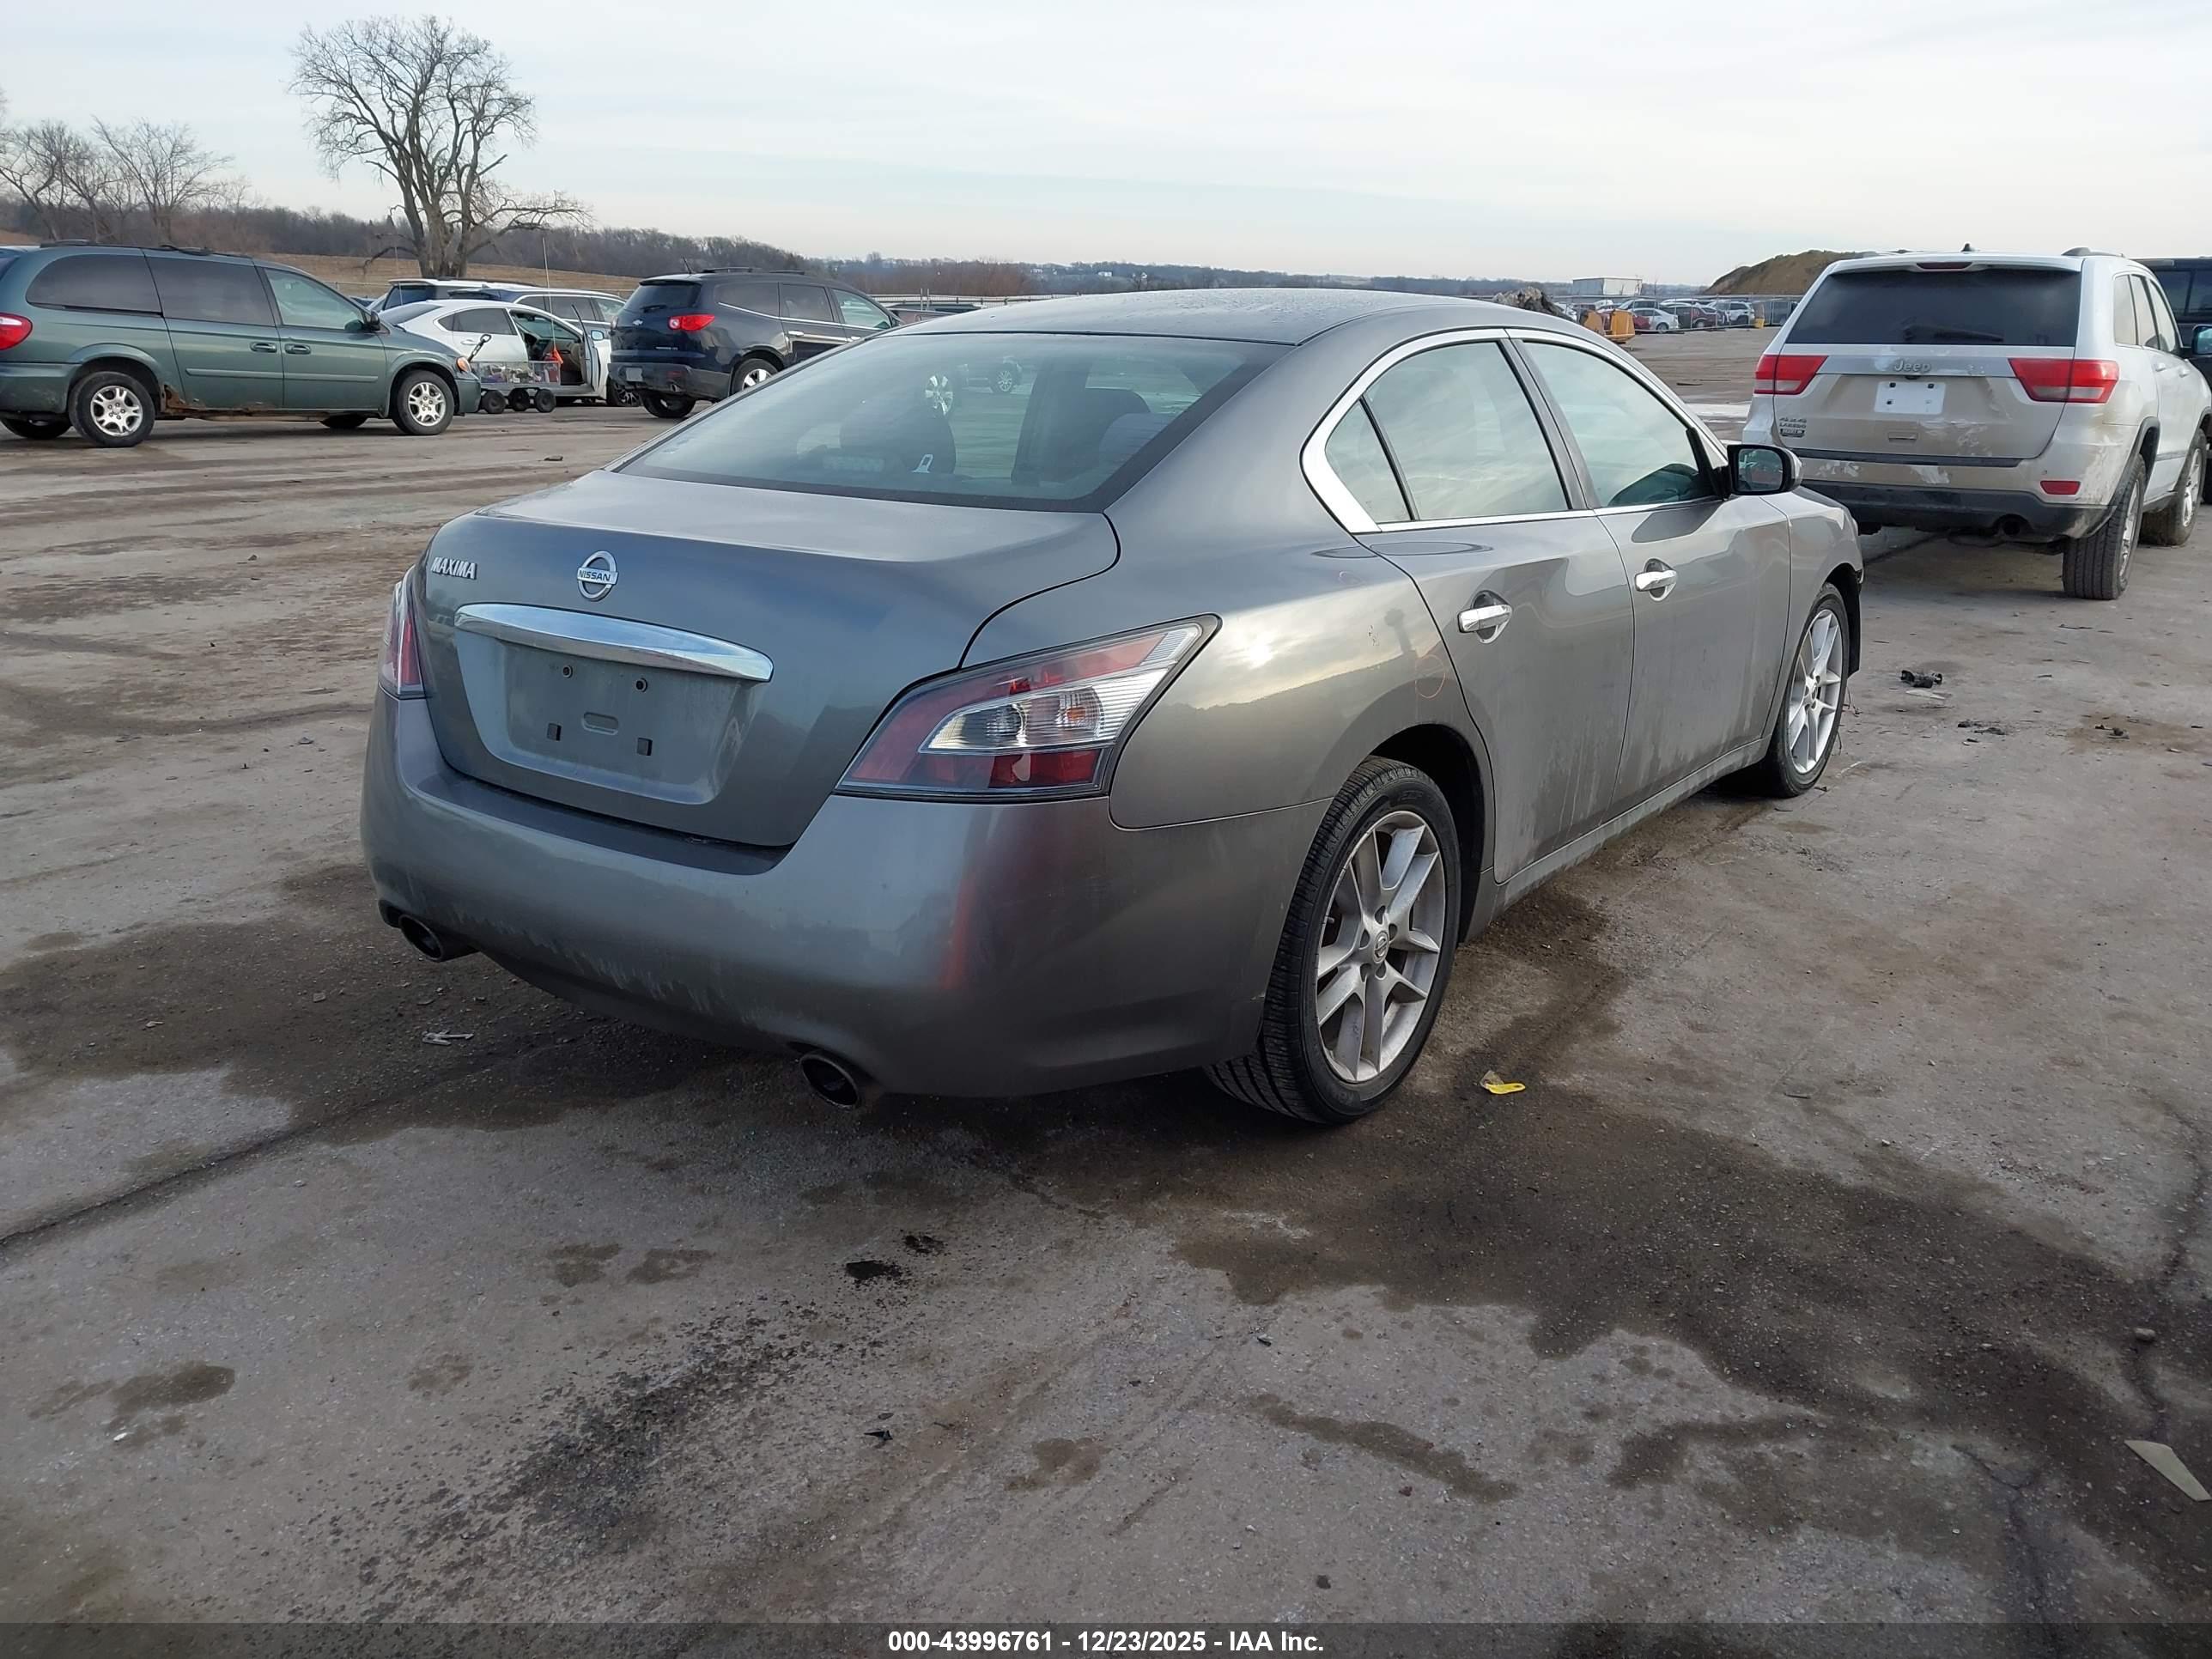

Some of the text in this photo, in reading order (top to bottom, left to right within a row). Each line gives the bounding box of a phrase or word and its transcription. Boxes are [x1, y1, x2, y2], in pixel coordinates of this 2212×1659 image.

[1894, 360, 1931, 373] Jeep
[431, 556, 477, 580] MAXIMA
[579, 569, 611, 581] NISSAN
